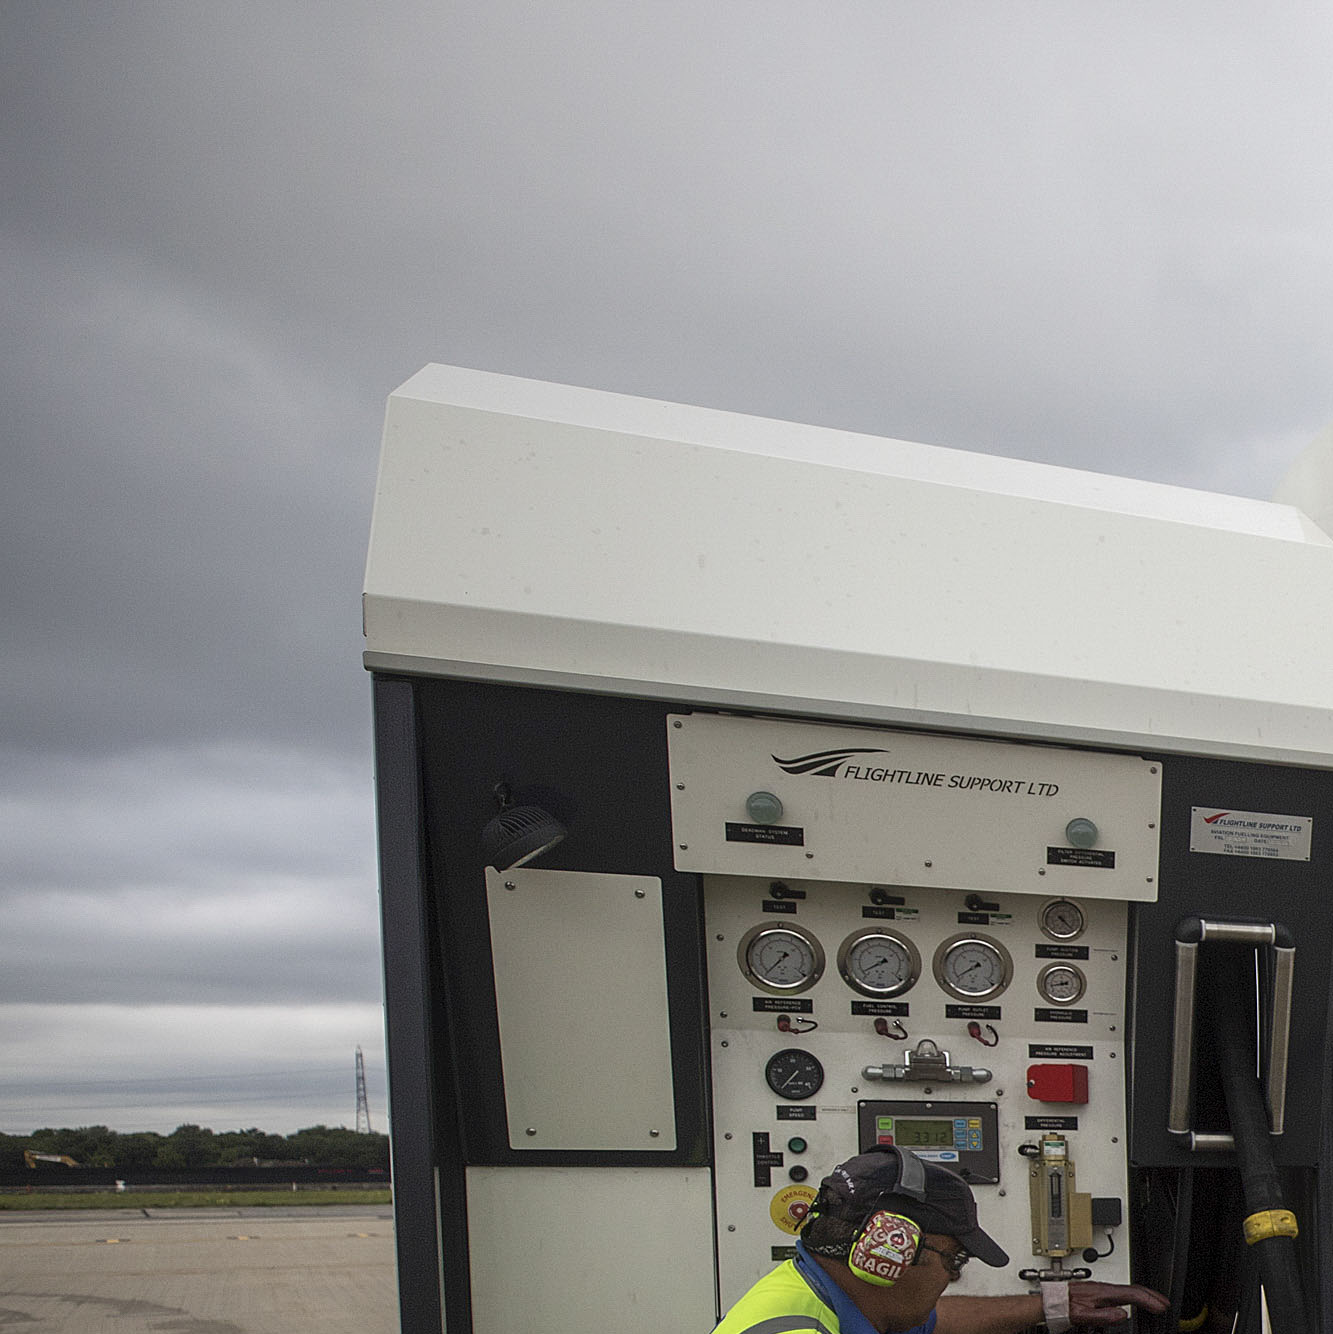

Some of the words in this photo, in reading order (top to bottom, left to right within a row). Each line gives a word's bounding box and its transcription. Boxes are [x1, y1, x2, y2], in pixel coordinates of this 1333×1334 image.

[844, 765, 945, 787] FLIGHTLINE
[947, 775, 1025, 795] SUPPORT
[1027, 782, 1059, 797] LTD
[1219, 819, 1257, 828] FLIGHTLINE
[1258, 822, 1289, 831] SUPPORT
[1289, 824, 1302, 832] LTD
